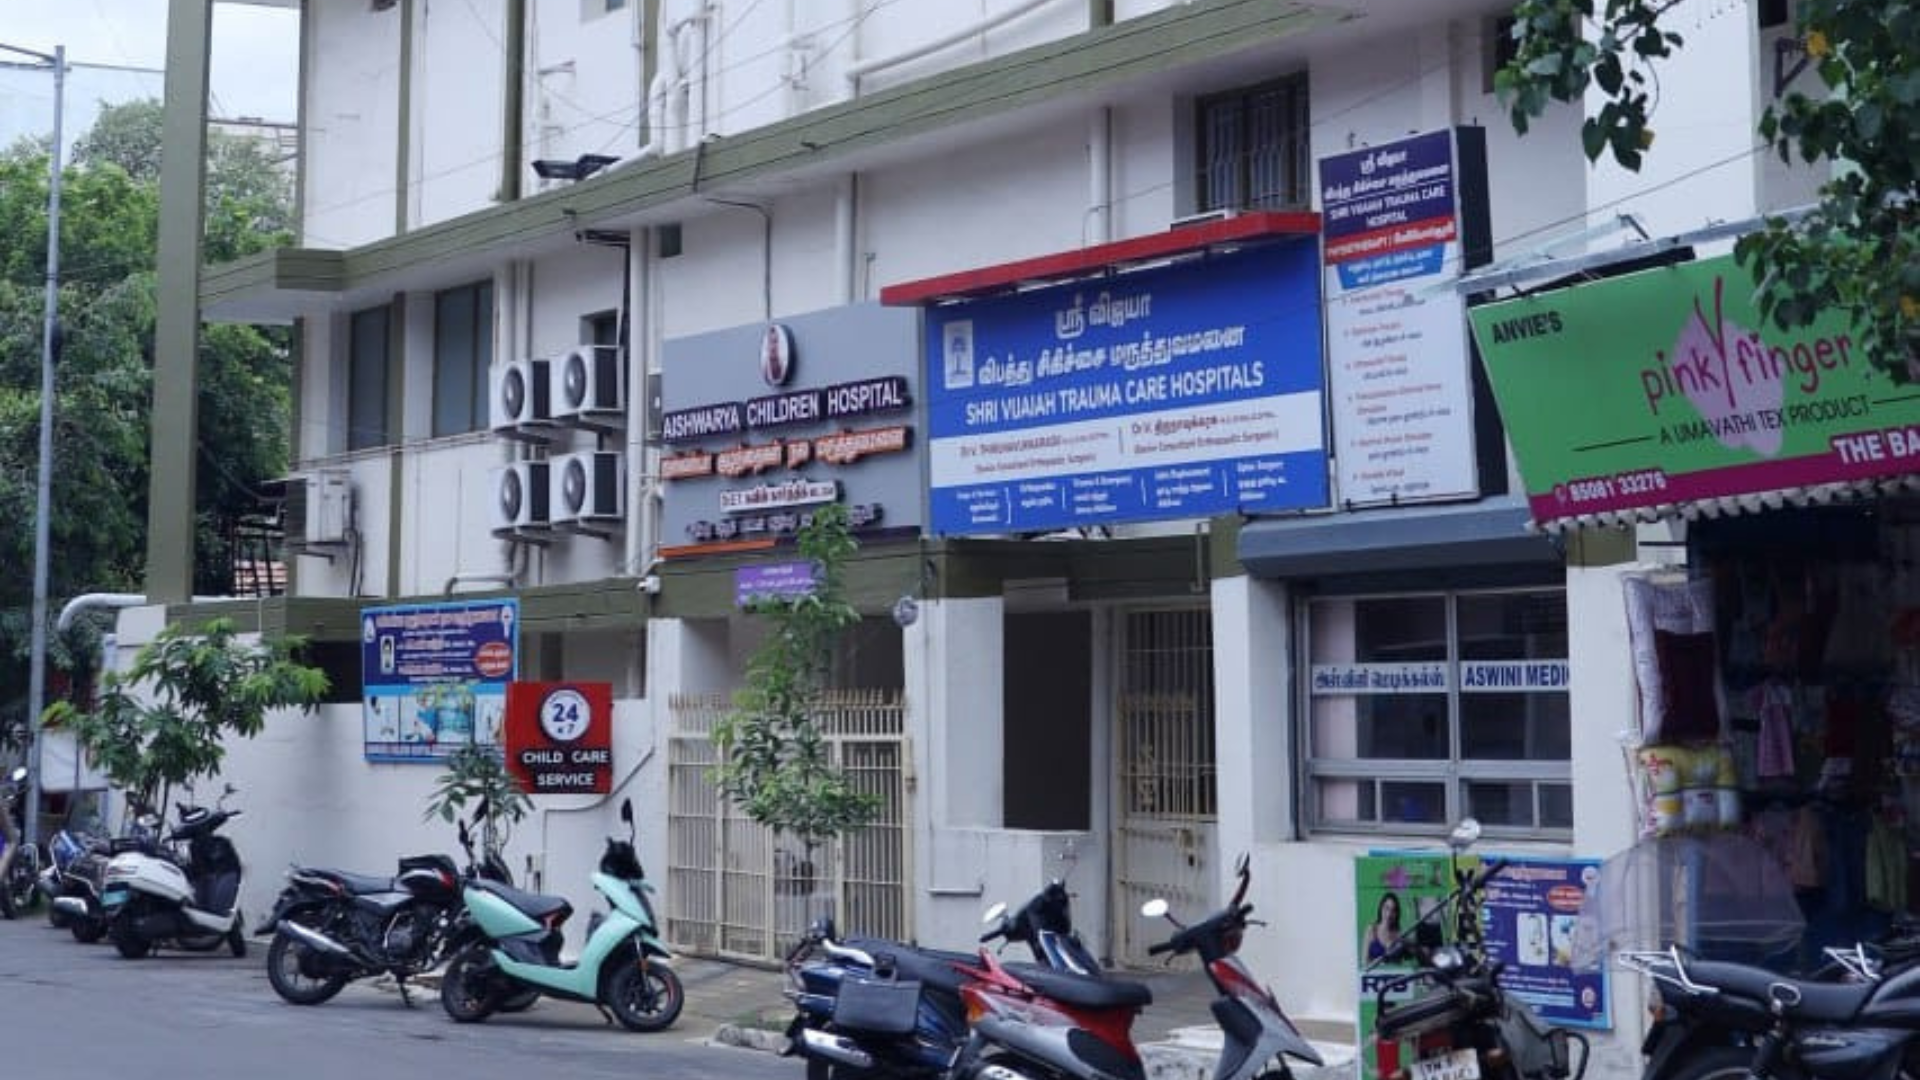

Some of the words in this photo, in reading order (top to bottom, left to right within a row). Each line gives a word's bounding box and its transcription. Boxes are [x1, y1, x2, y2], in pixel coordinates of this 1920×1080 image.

[1422, 185, 1445, 200] CARE
[1088, 291, 1151, 327] விஜயா
[1491, 310, 1563, 344] ANVIE'S
[978, 351, 1034, 388] விபத்து
[1037, 342, 1106, 377] சிகிச்சை
[1110, 326, 1244, 371] மருத்துவமனை
[1736, 333, 1852, 393] finger
[664, 406, 740, 439] AISHWARYA
[747, 391, 819, 427] CHILDREN
[828, 379, 902, 415] HOSPITAL
[966, 399, 998, 426] SHRI
[1059, 381, 1121, 415] TRAUMA
[1125, 374, 1166, 405] CARE
[1171, 361, 1264, 399] HOSPITALS
[1660, 430, 1671, 445] A
[1673, 416, 1757, 442] UMAVATHI
[1758, 407, 1786, 429] TEX
[1789, 394, 1871, 425] PRODUCT
[1833, 434, 1885, 464] THE
[1464, 665, 1524, 687] ASWINI
[552, 703, 579, 722] 24
[522, 751, 563, 764] CHILD
[571, 750, 609, 764] CARE
[537, 773, 595, 786] SERVICE
